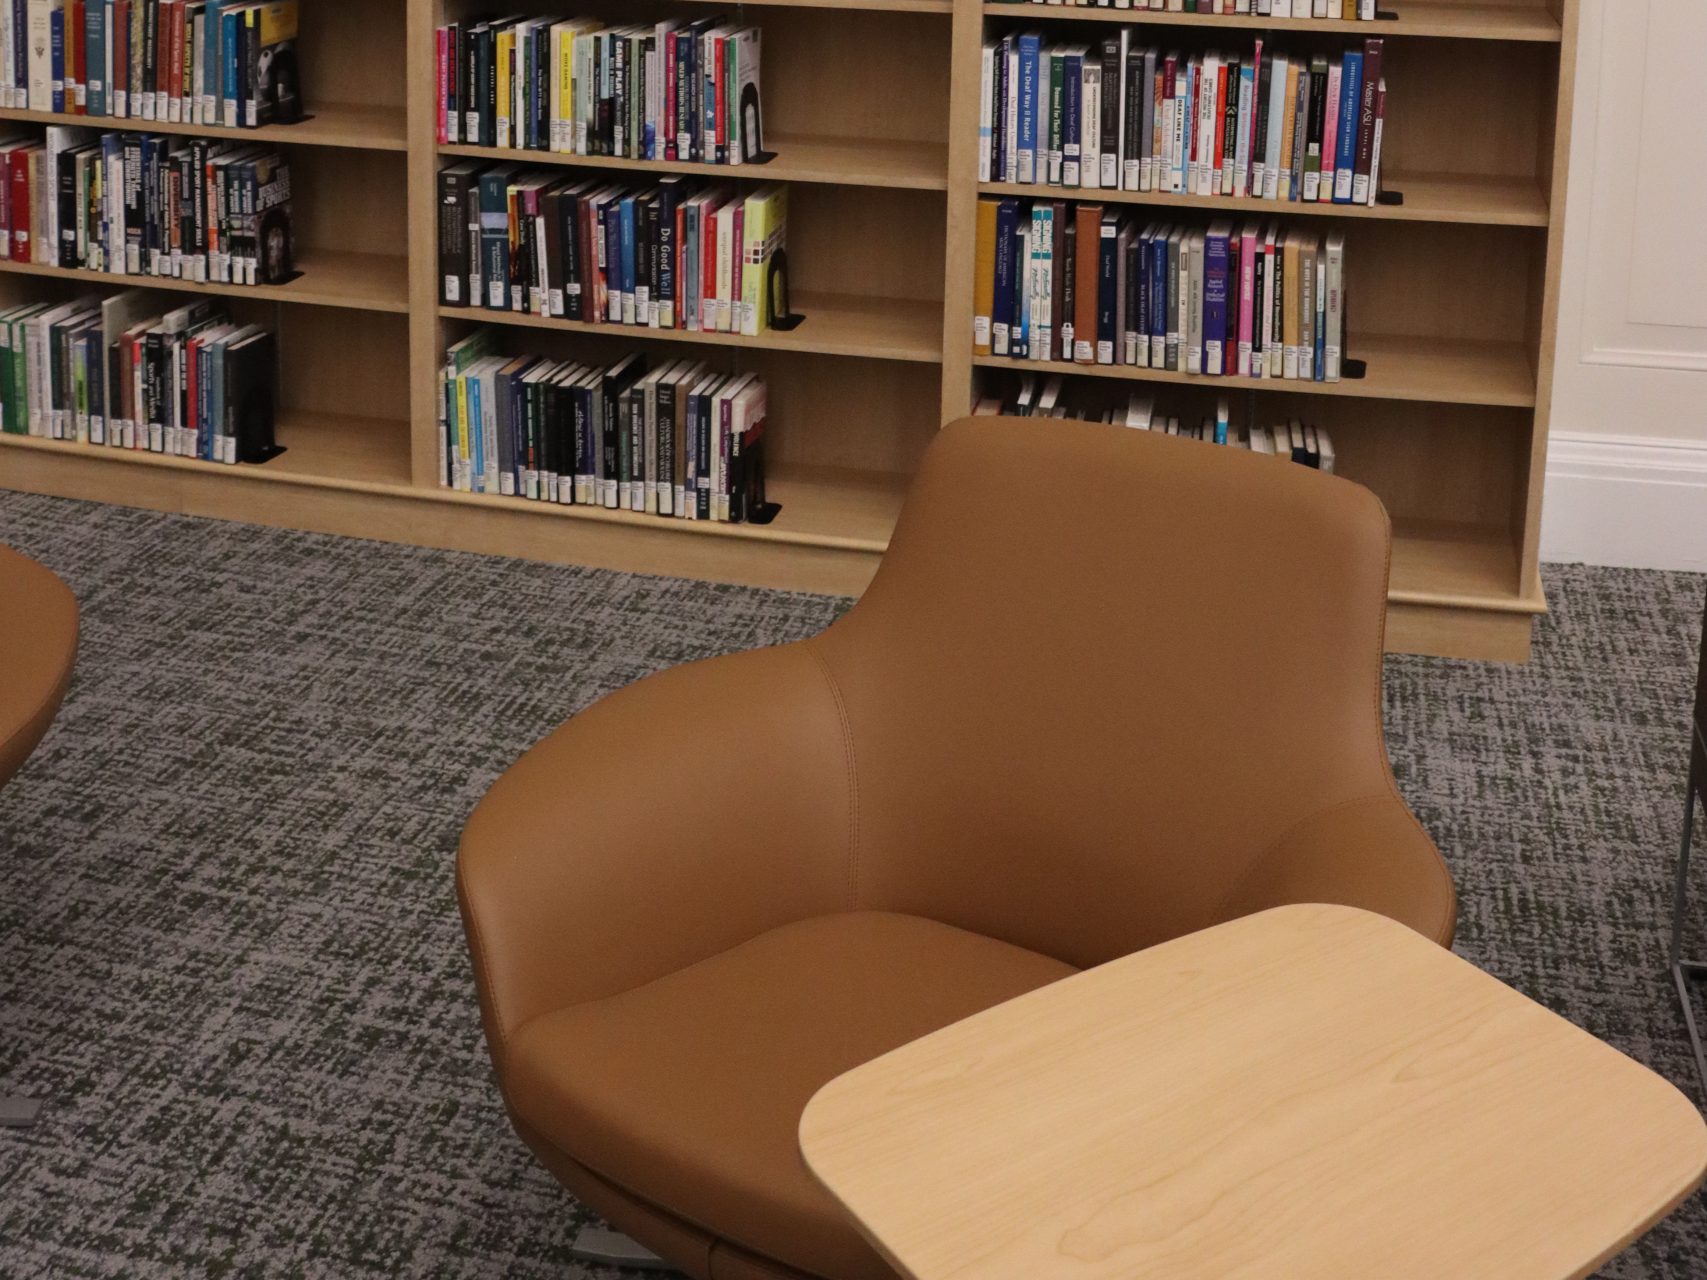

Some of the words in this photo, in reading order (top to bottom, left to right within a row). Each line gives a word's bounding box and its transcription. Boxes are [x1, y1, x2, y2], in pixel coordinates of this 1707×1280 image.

[1024, 76, 1032, 92] Deaf
[1363, 81, 1375, 107] Master
[1023, 93, 1031, 109] Way
[1241, 85, 1250, 111] Reading
[1053, 110, 1061, 118] for
[1053, 119, 1061, 133] Their
[194, 147, 202, 170] APPLIED
[194, 170, 202, 188] SPORT
[195, 228, 203, 246] SKILLS
[660, 227, 671, 242] Do
[720, 232, 728, 256] unequal
[1032, 220, 1042, 254] SIGNING
[1042, 220, 1052, 254] SIGNING
[660, 245, 671, 270] Good
[661, 272, 671, 295] Well
[147, 363, 155, 384] Sports
[149, 398, 157, 419] Media
[732, 432, 740, 457] VIOLENCE
